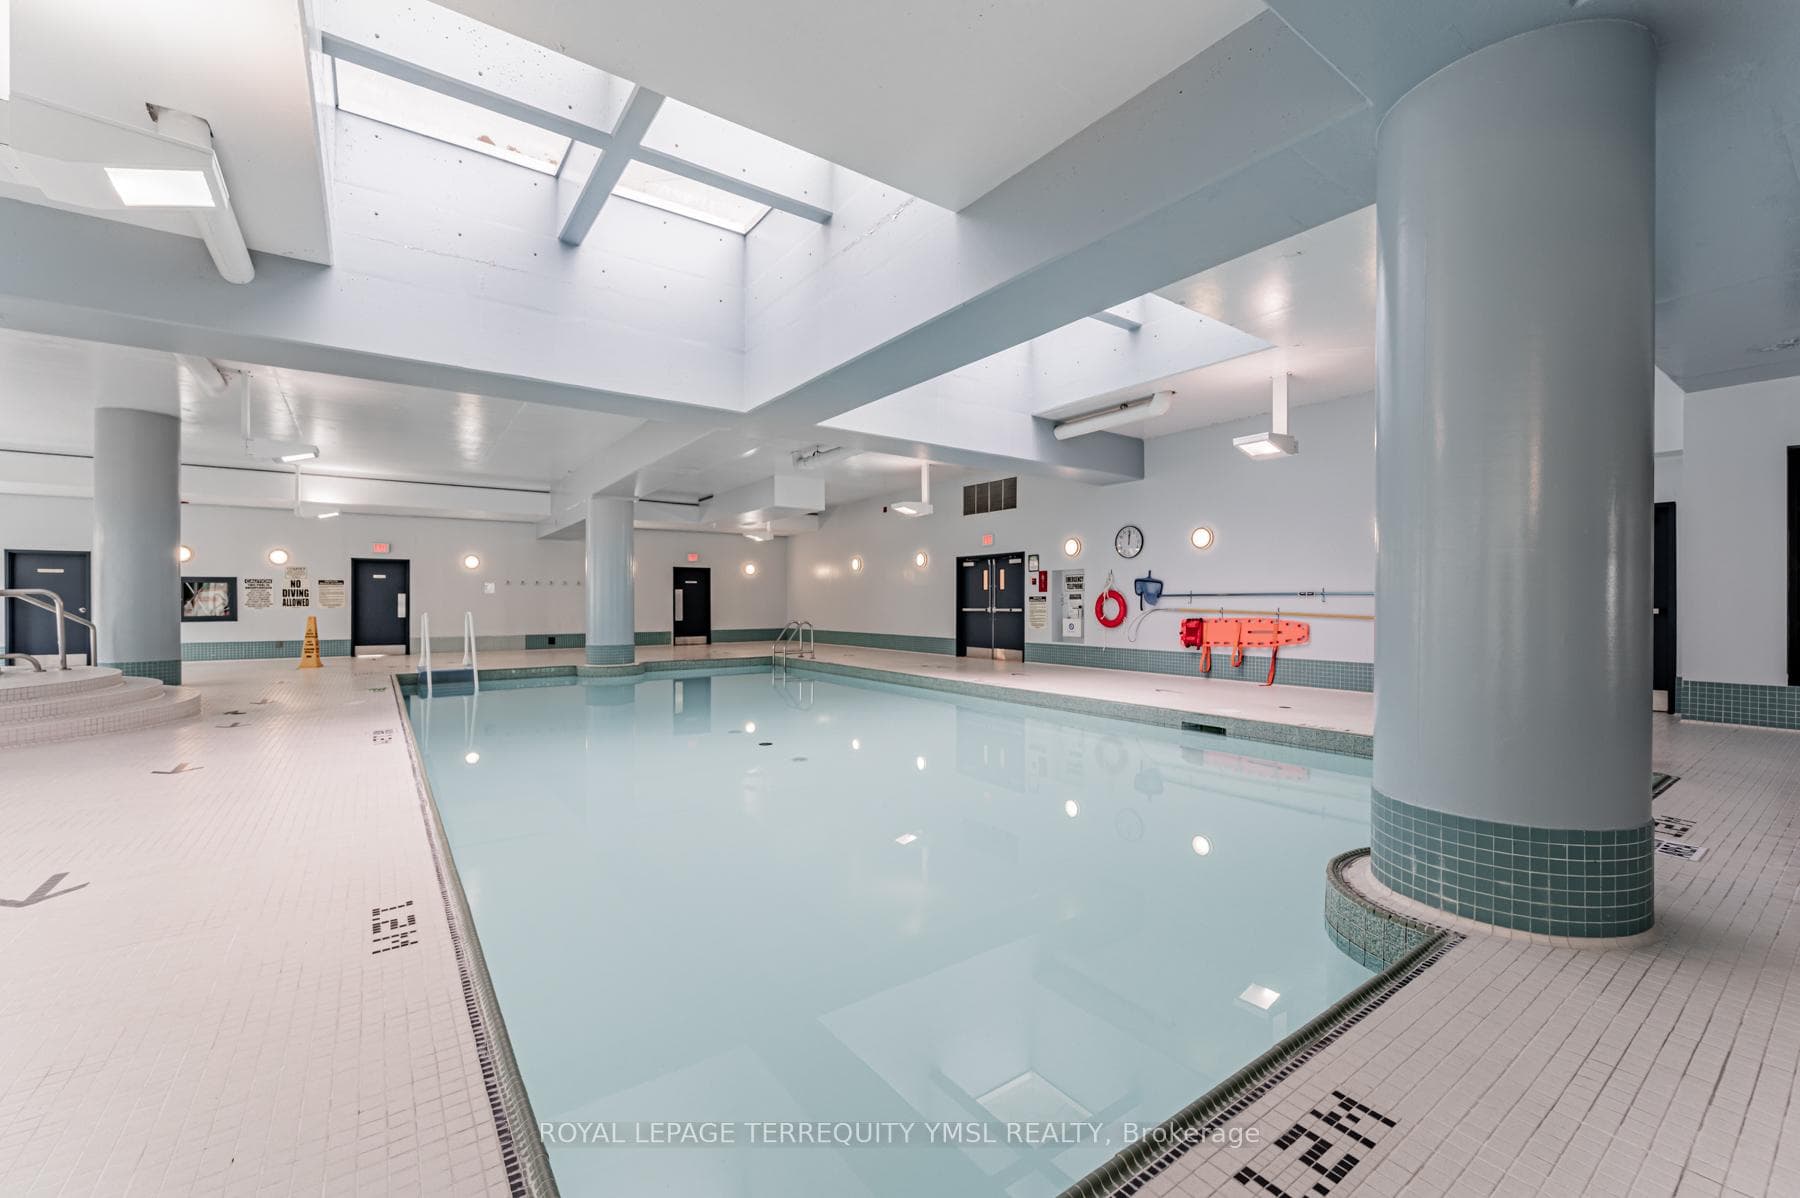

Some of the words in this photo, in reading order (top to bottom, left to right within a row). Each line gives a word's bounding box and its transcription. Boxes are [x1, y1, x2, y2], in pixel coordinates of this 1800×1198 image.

[290, 579, 302, 588] NO
[282, 589, 310, 597] DIVING
[282, 598, 310, 606] ALLOWED
